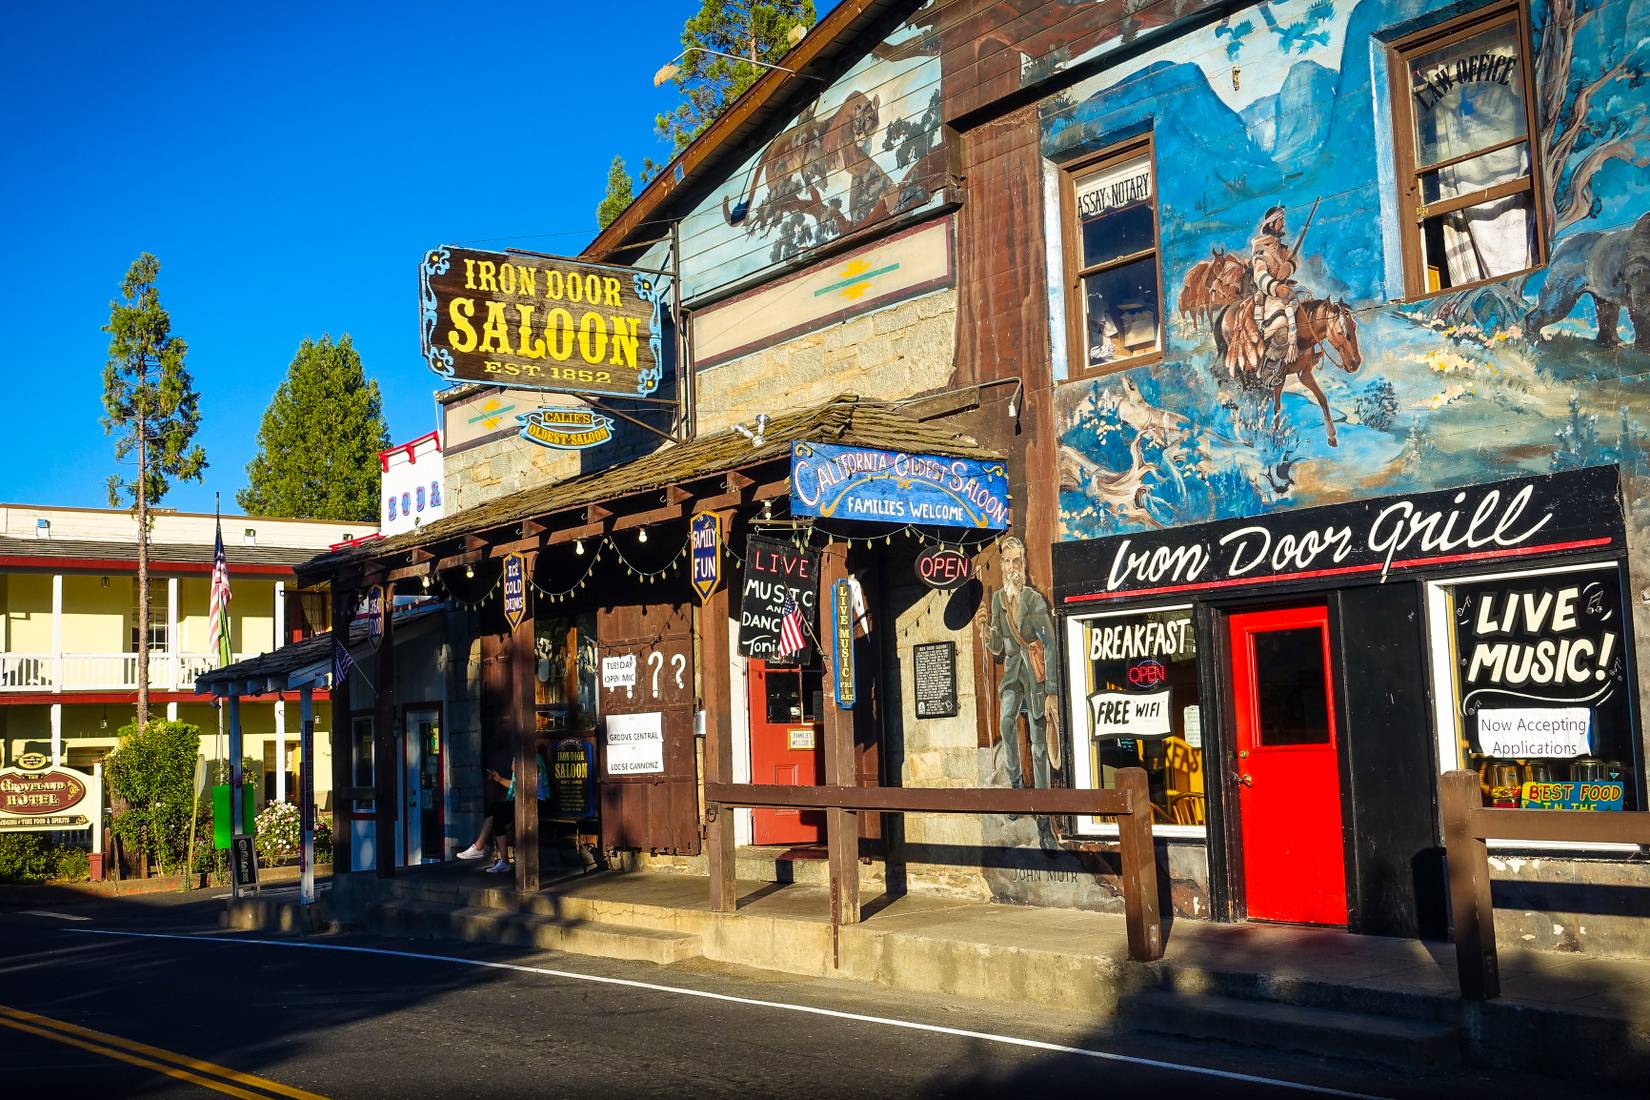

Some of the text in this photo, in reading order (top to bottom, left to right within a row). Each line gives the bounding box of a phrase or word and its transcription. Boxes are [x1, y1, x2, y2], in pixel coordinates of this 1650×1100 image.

[1414, 54, 1518, 112] LAW OFFICE
[1111, 173, 1149, 206] NOTARY
[464, 259, 622, 307] IRON DOOR
[448, 297, 641, 370] SALOON
[528, 424, 608, 446] OLDEST SALOON
[388, 481, 441, 521] SODA
[949, 461, 1008, 525] SALOON
[848, 496, 964, 521] FAMILIES WELCOME
[693, 528, 716, 548] FAMILY
[1106, 483, 1554, 591] Iron Door Grill
[694, 556, 716, 579] FUN
[755, 550, 809, 578] LIVE
[920, 557, 969, 578] OPEN
[506, 579, 522, 595] COLD
[744, 579, 814, 607] MUSIC
[840, 587, 849, 625] LIVE
[1476, 587, 1579, 635] LIVE
[1090, 618, 1196, 661] BREAKFAST
[840, 629, 850, 678] MUSIC
[1467, 632, 1615, 683] MUSIC!
[606, 660, 634, 670] TUESDAY
[1128, 665, 1166, 683] OPEN
[604, 673, 634, 684] OPEN MIC
[1097, 700, 1130, 725] FREE
[1135, 701, 1161, 718] WIFI
[609, 731, 659, 742] GROOVE CENTRAL
[1481, 717, 1586, 735] Now Accepting
[1493, 740, 1577, 759] Applications
[555, 763, 588, 779] SALOON
[610, 762, 628, 771] LOOSE
[0, 778, 66, 793] GROVELAND
[1529, 784, 1622, 801] BEST FOOD
[7, 794, 59, 807] HOTEL
[1012, 868, 1079, 882] JOHN MUIR
